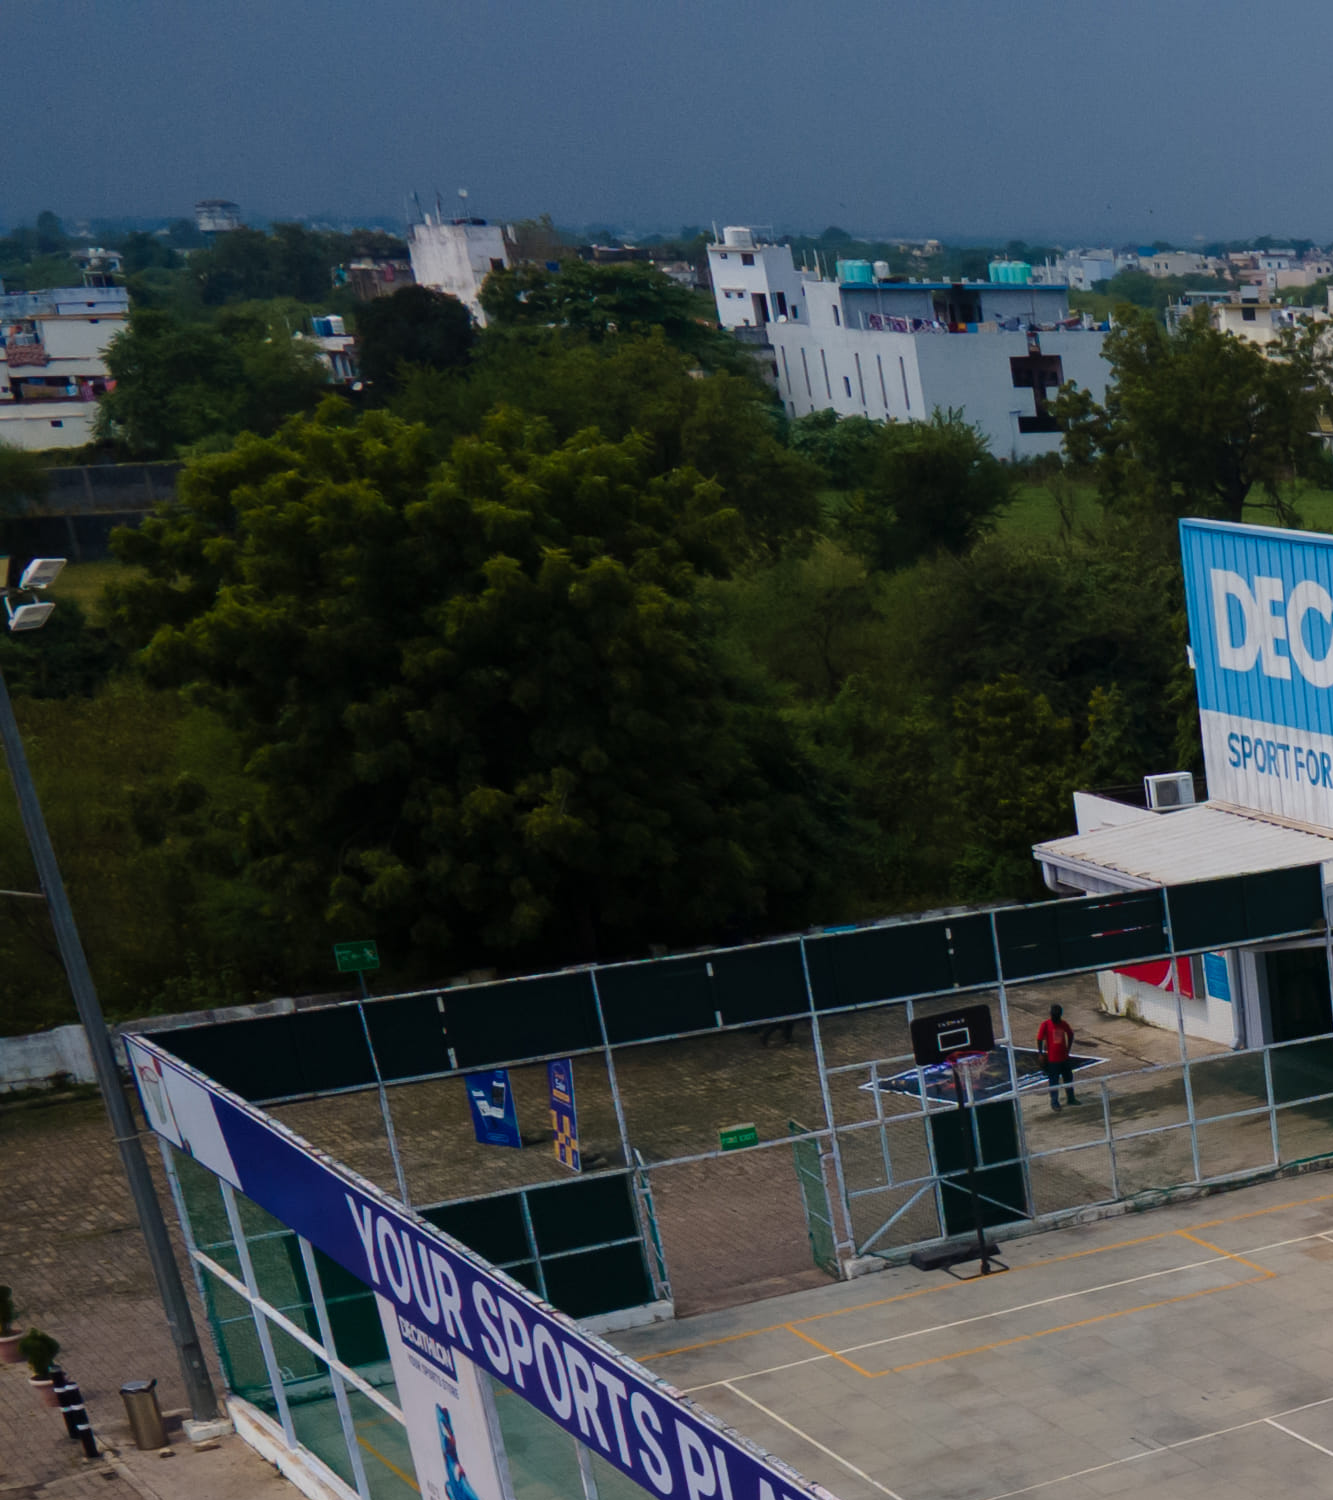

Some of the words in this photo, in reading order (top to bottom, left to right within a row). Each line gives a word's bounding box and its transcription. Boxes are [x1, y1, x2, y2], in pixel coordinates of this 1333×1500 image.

[1227, 732, 1290, 779] SPORT
[1294, 746, 1333, 790] FOR
[344, 1192, 474, 1351] YOUR
[472, 1280, 673, 1496] SPORTS
[398, 1314, 455, 1372] DECATHLON
